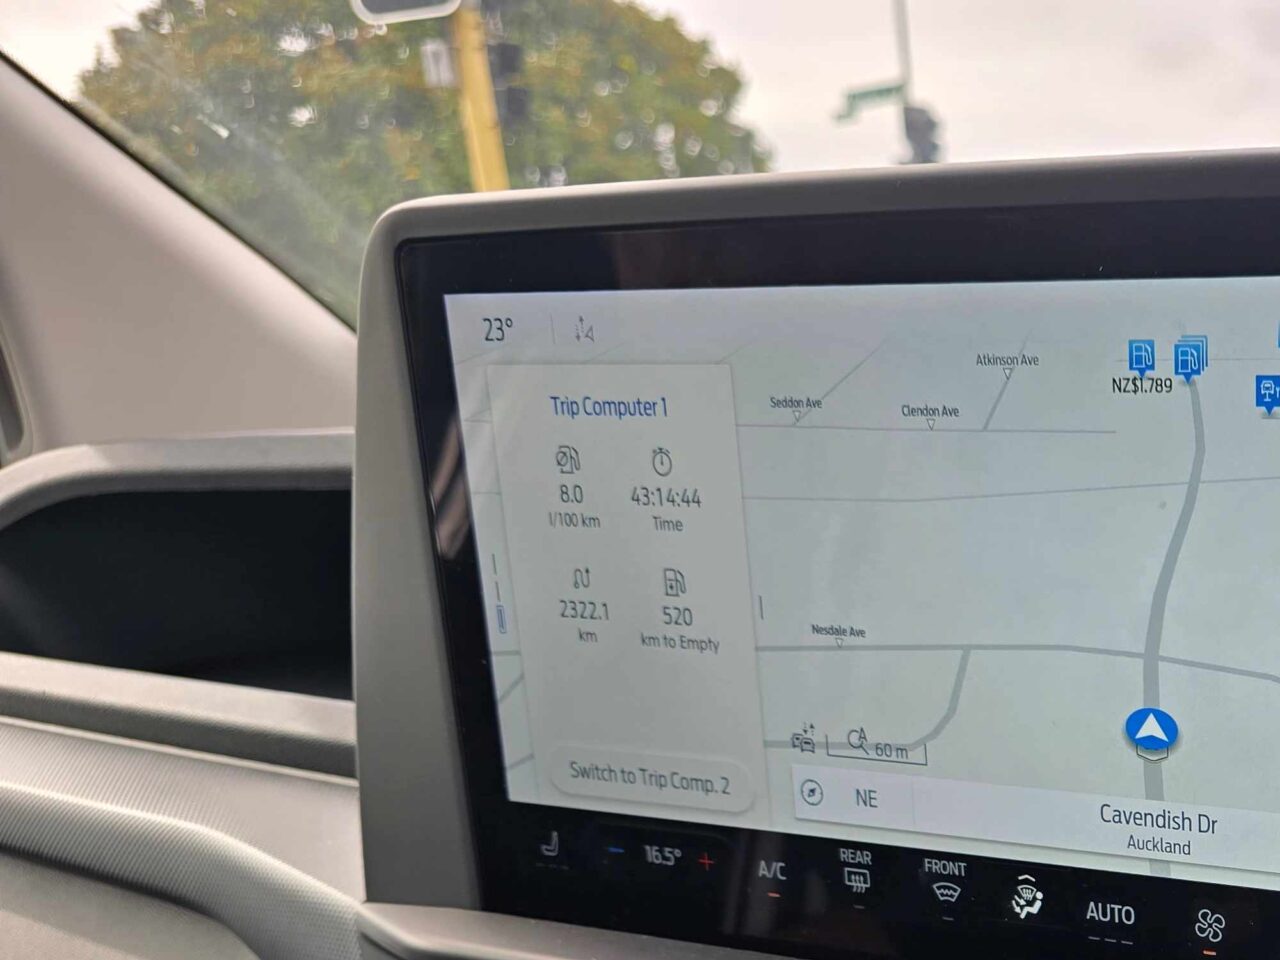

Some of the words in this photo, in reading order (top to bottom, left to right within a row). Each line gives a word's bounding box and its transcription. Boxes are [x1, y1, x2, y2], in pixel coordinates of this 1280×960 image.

[482, 316, 514, 343] 23°
[975, 353, 1016, 366] Atkinson
[1018, 353, 1040, 366] Ave
[1111, 377, 1174, 395] NZ$1.789
[550, 396, 580, 420] Trip
[582, 397, 657, 420] Computer
[659, 397, 668, 418] 1
[770, 397, 802, 409] Seddon
[804, 398, 823, 409] Ave
[901, 405, 938, 417] Clendon
[940, 406, 959, 418] Ave
[559, 484, 584, 505] 8.0
[631, 486, 702, 509] 43:14:44
[580, 513, 601, 530] km
[652, 516, 684, 533] Time
[559, 599, 610, 621] 2322.1
[662, 606, 693, 626] 520
[578, 627, 599, 643] km
[811, 624, 847, 637] Nesdale
[848, 626, 867, 639] Ave
[640, 632, 661, 649] km
[664, 635, 678, 650] to
[681, 635, 720, 655] Empty
[875, 742, 892, 758] 60
[895, 747, 909, 760] m
[570, 762, 617, 784] Switch
[619, 766, 636, 786] to
[639, 769, 668, 792] Trip
[671, 773, 718, 796] Comp.
[720, 777, 731, 796] 2
[856, 789, 878, 809] NE
[1099, 804, 1192, 833] Cavendish
[1197, 813, 1218, 834] Dr
[1127, 834, 1191, 855] Auckland
[839, 849, 872, 866] REAR
[758, 859, 788, 881] A/C
[923, 859, 968, 877] FRONT
[1085, 902, 1136, 926] AUTO
